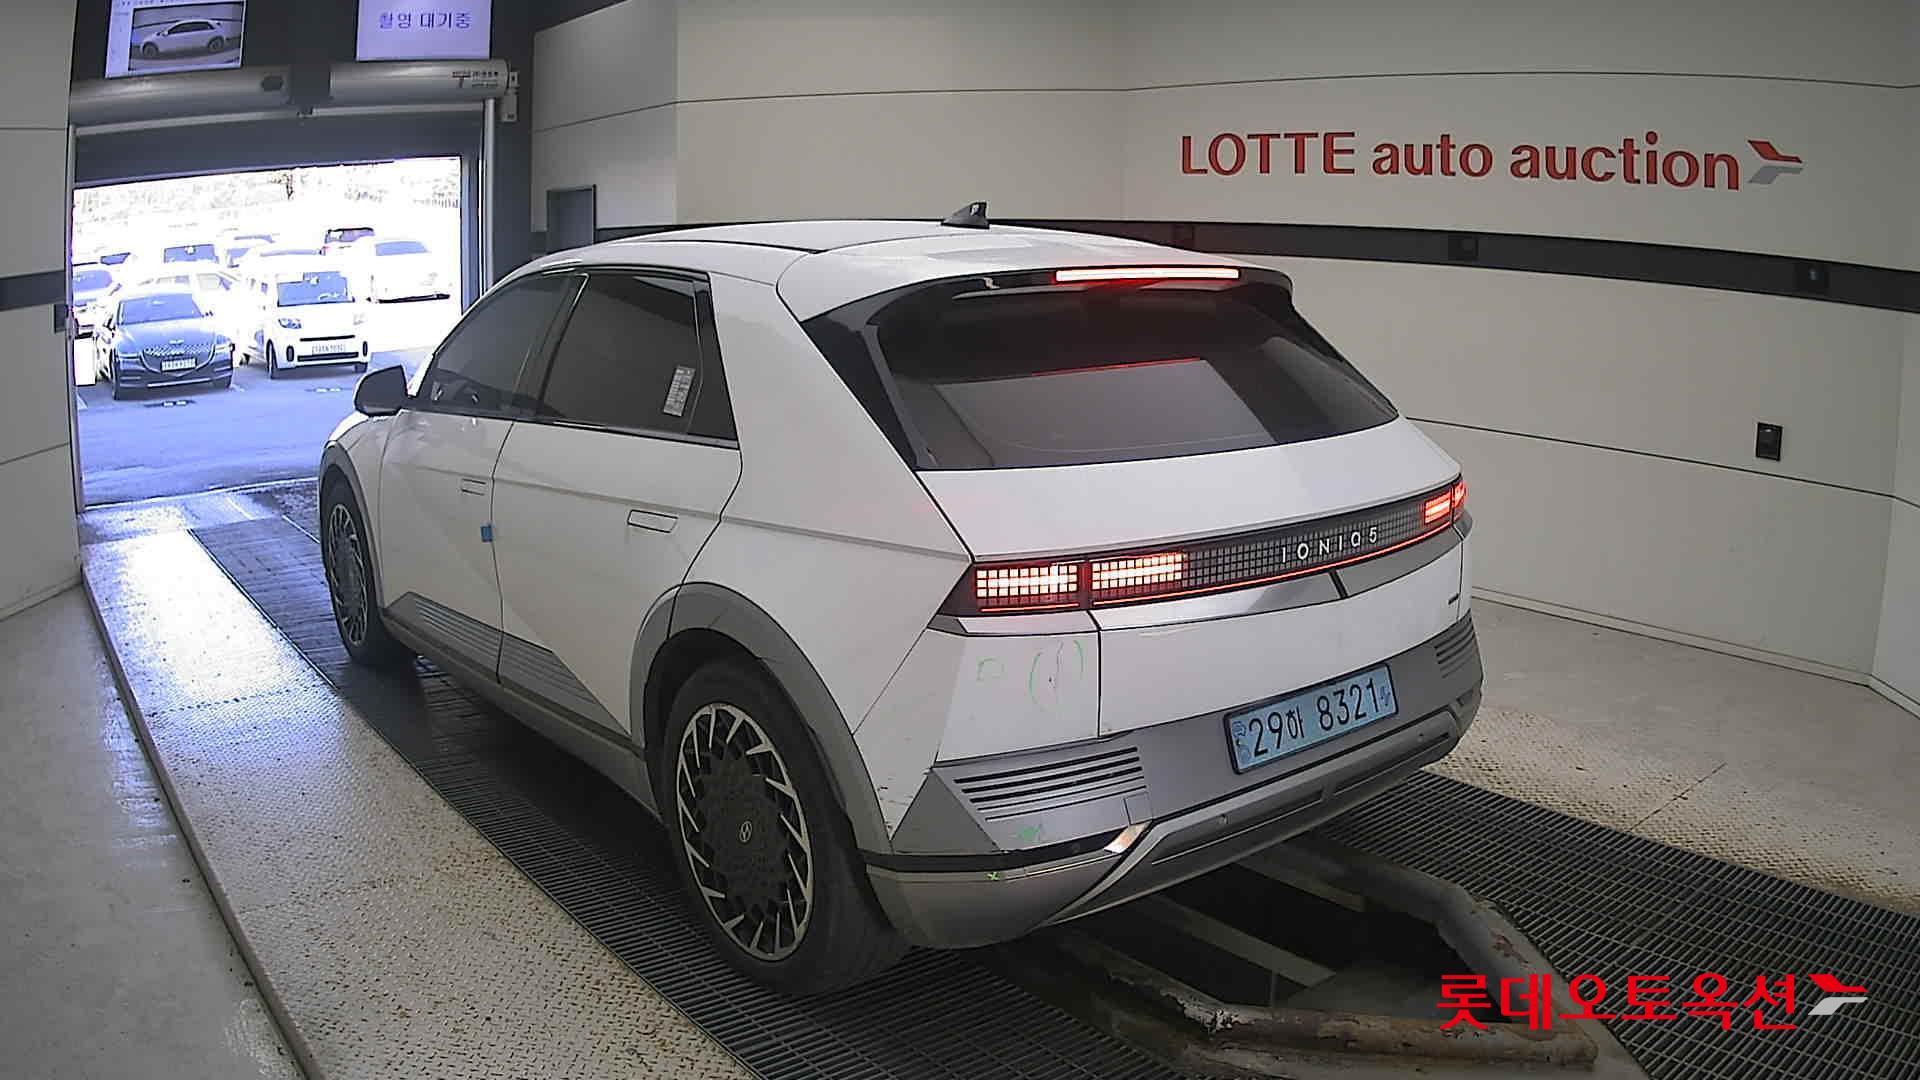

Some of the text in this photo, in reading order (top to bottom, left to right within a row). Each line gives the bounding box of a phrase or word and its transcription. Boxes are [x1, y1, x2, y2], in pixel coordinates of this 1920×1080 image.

[420, 11, 472, 30] 대기중
[1181, 130, 1740, 190] LOTTE auto auction
[1248, 677, 1380, 758] 29하 8321
